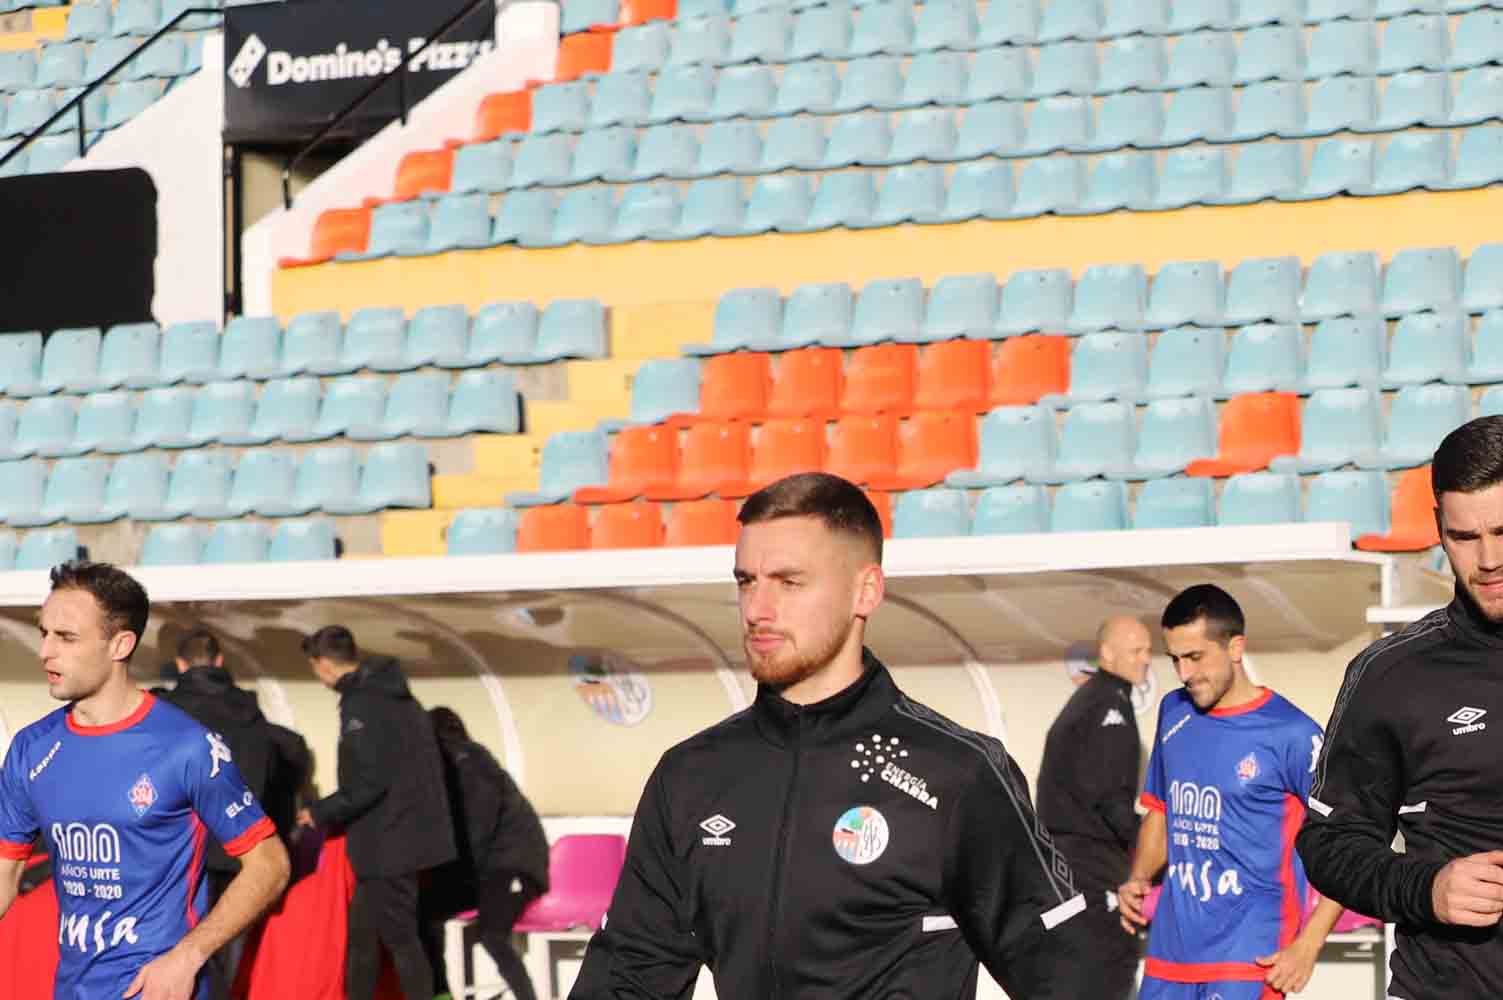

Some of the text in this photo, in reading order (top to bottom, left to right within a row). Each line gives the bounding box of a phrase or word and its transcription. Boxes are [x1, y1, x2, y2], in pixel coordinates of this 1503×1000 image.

[266, 39, 402, 84] Domino's
[1452, 721, 1486, 736] umbro
[880, 769, 939, 810] CHARRA
[89, 868, 121, 880] URTE
[94, 884, 122, 900] 2020
